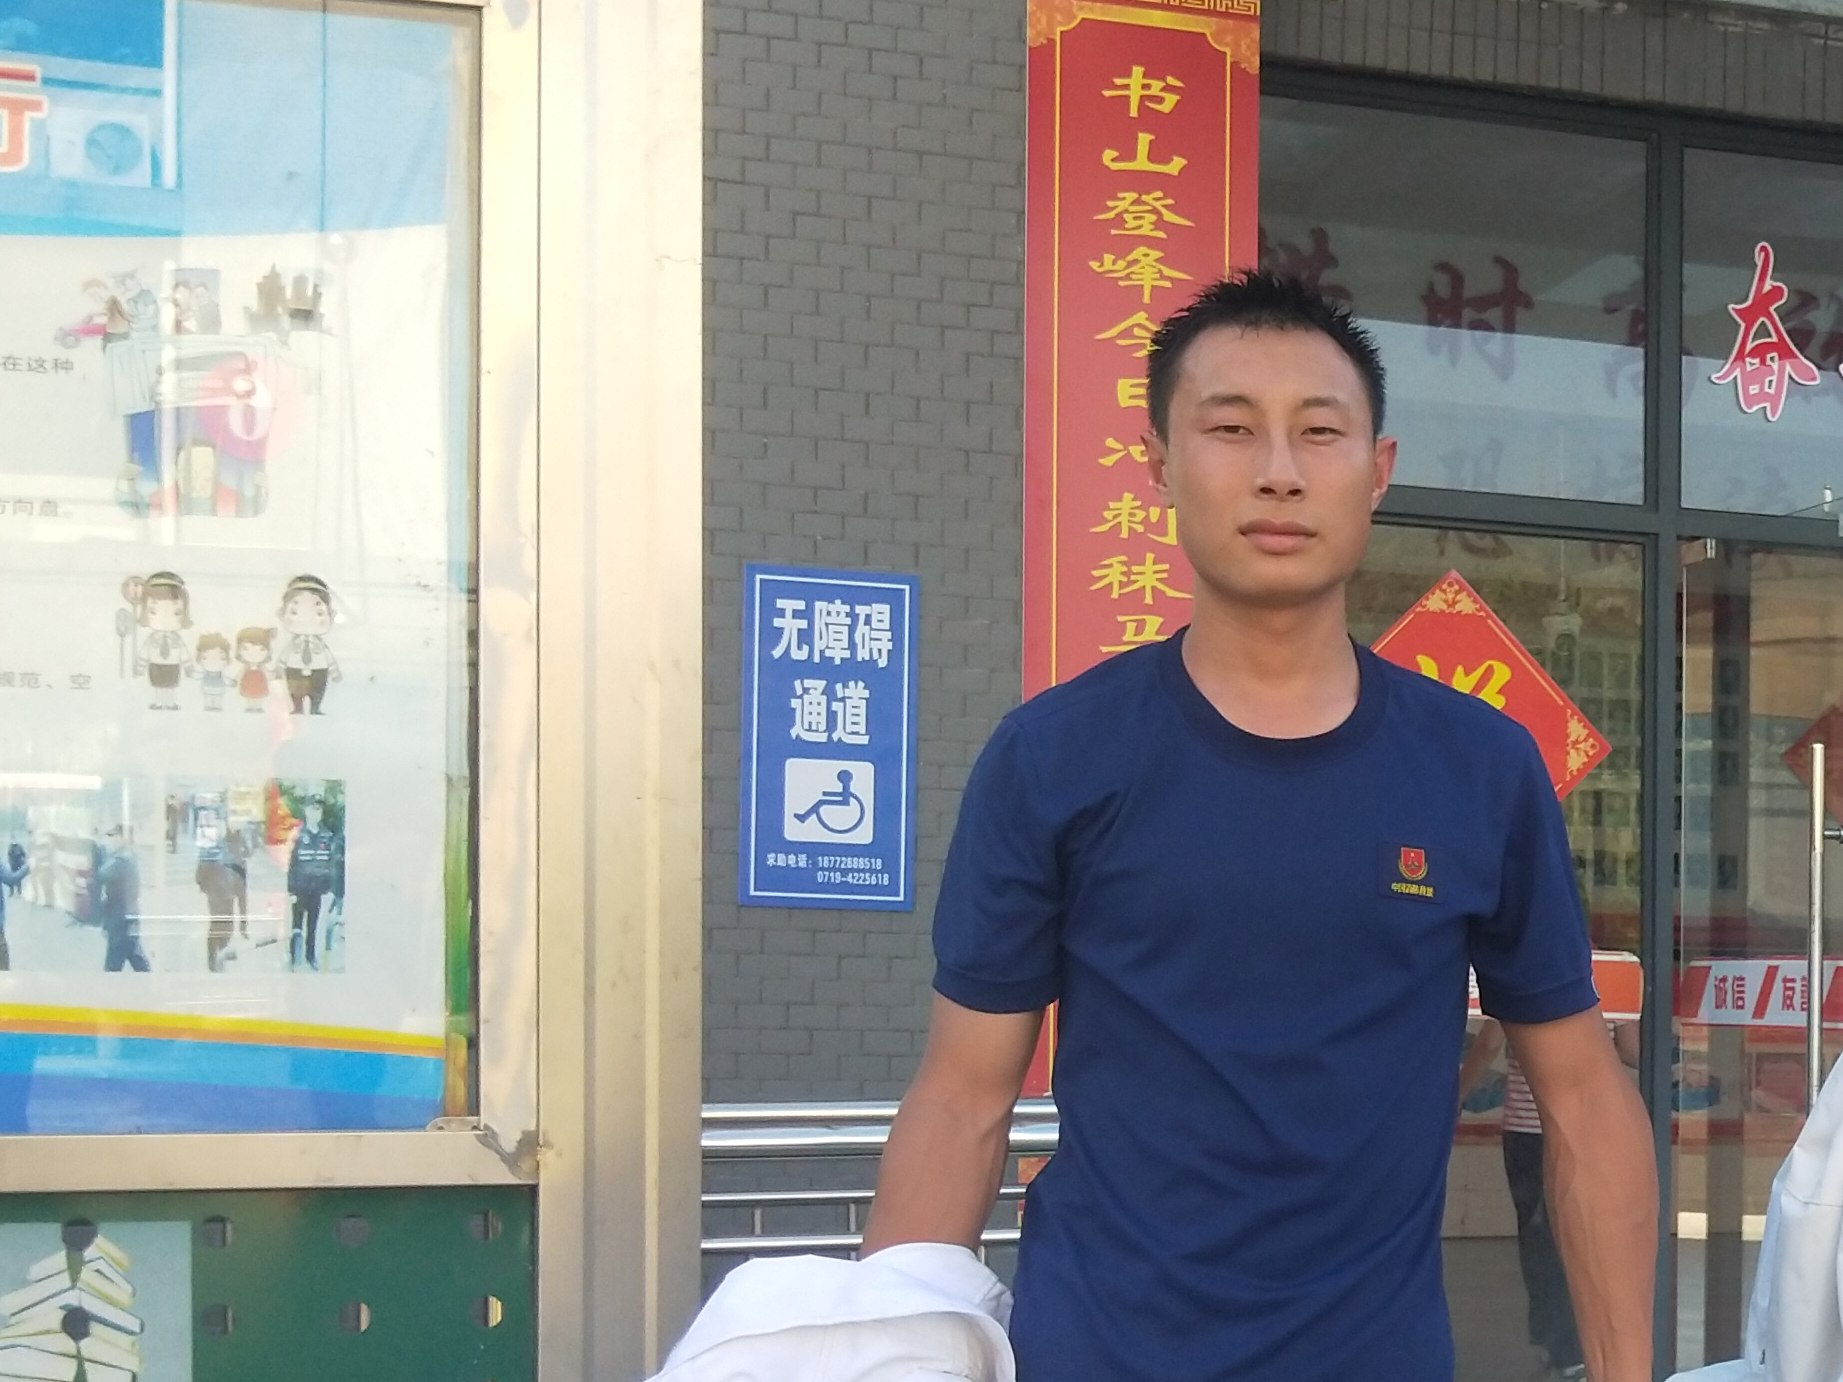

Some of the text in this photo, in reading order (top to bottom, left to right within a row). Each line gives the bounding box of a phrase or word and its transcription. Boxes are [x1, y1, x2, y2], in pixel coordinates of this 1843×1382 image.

[772, 598, 893, 668] 无障碍
[790, 679, 871, 745] 通道
[1714, 975, 1746, 1010] 诚信
